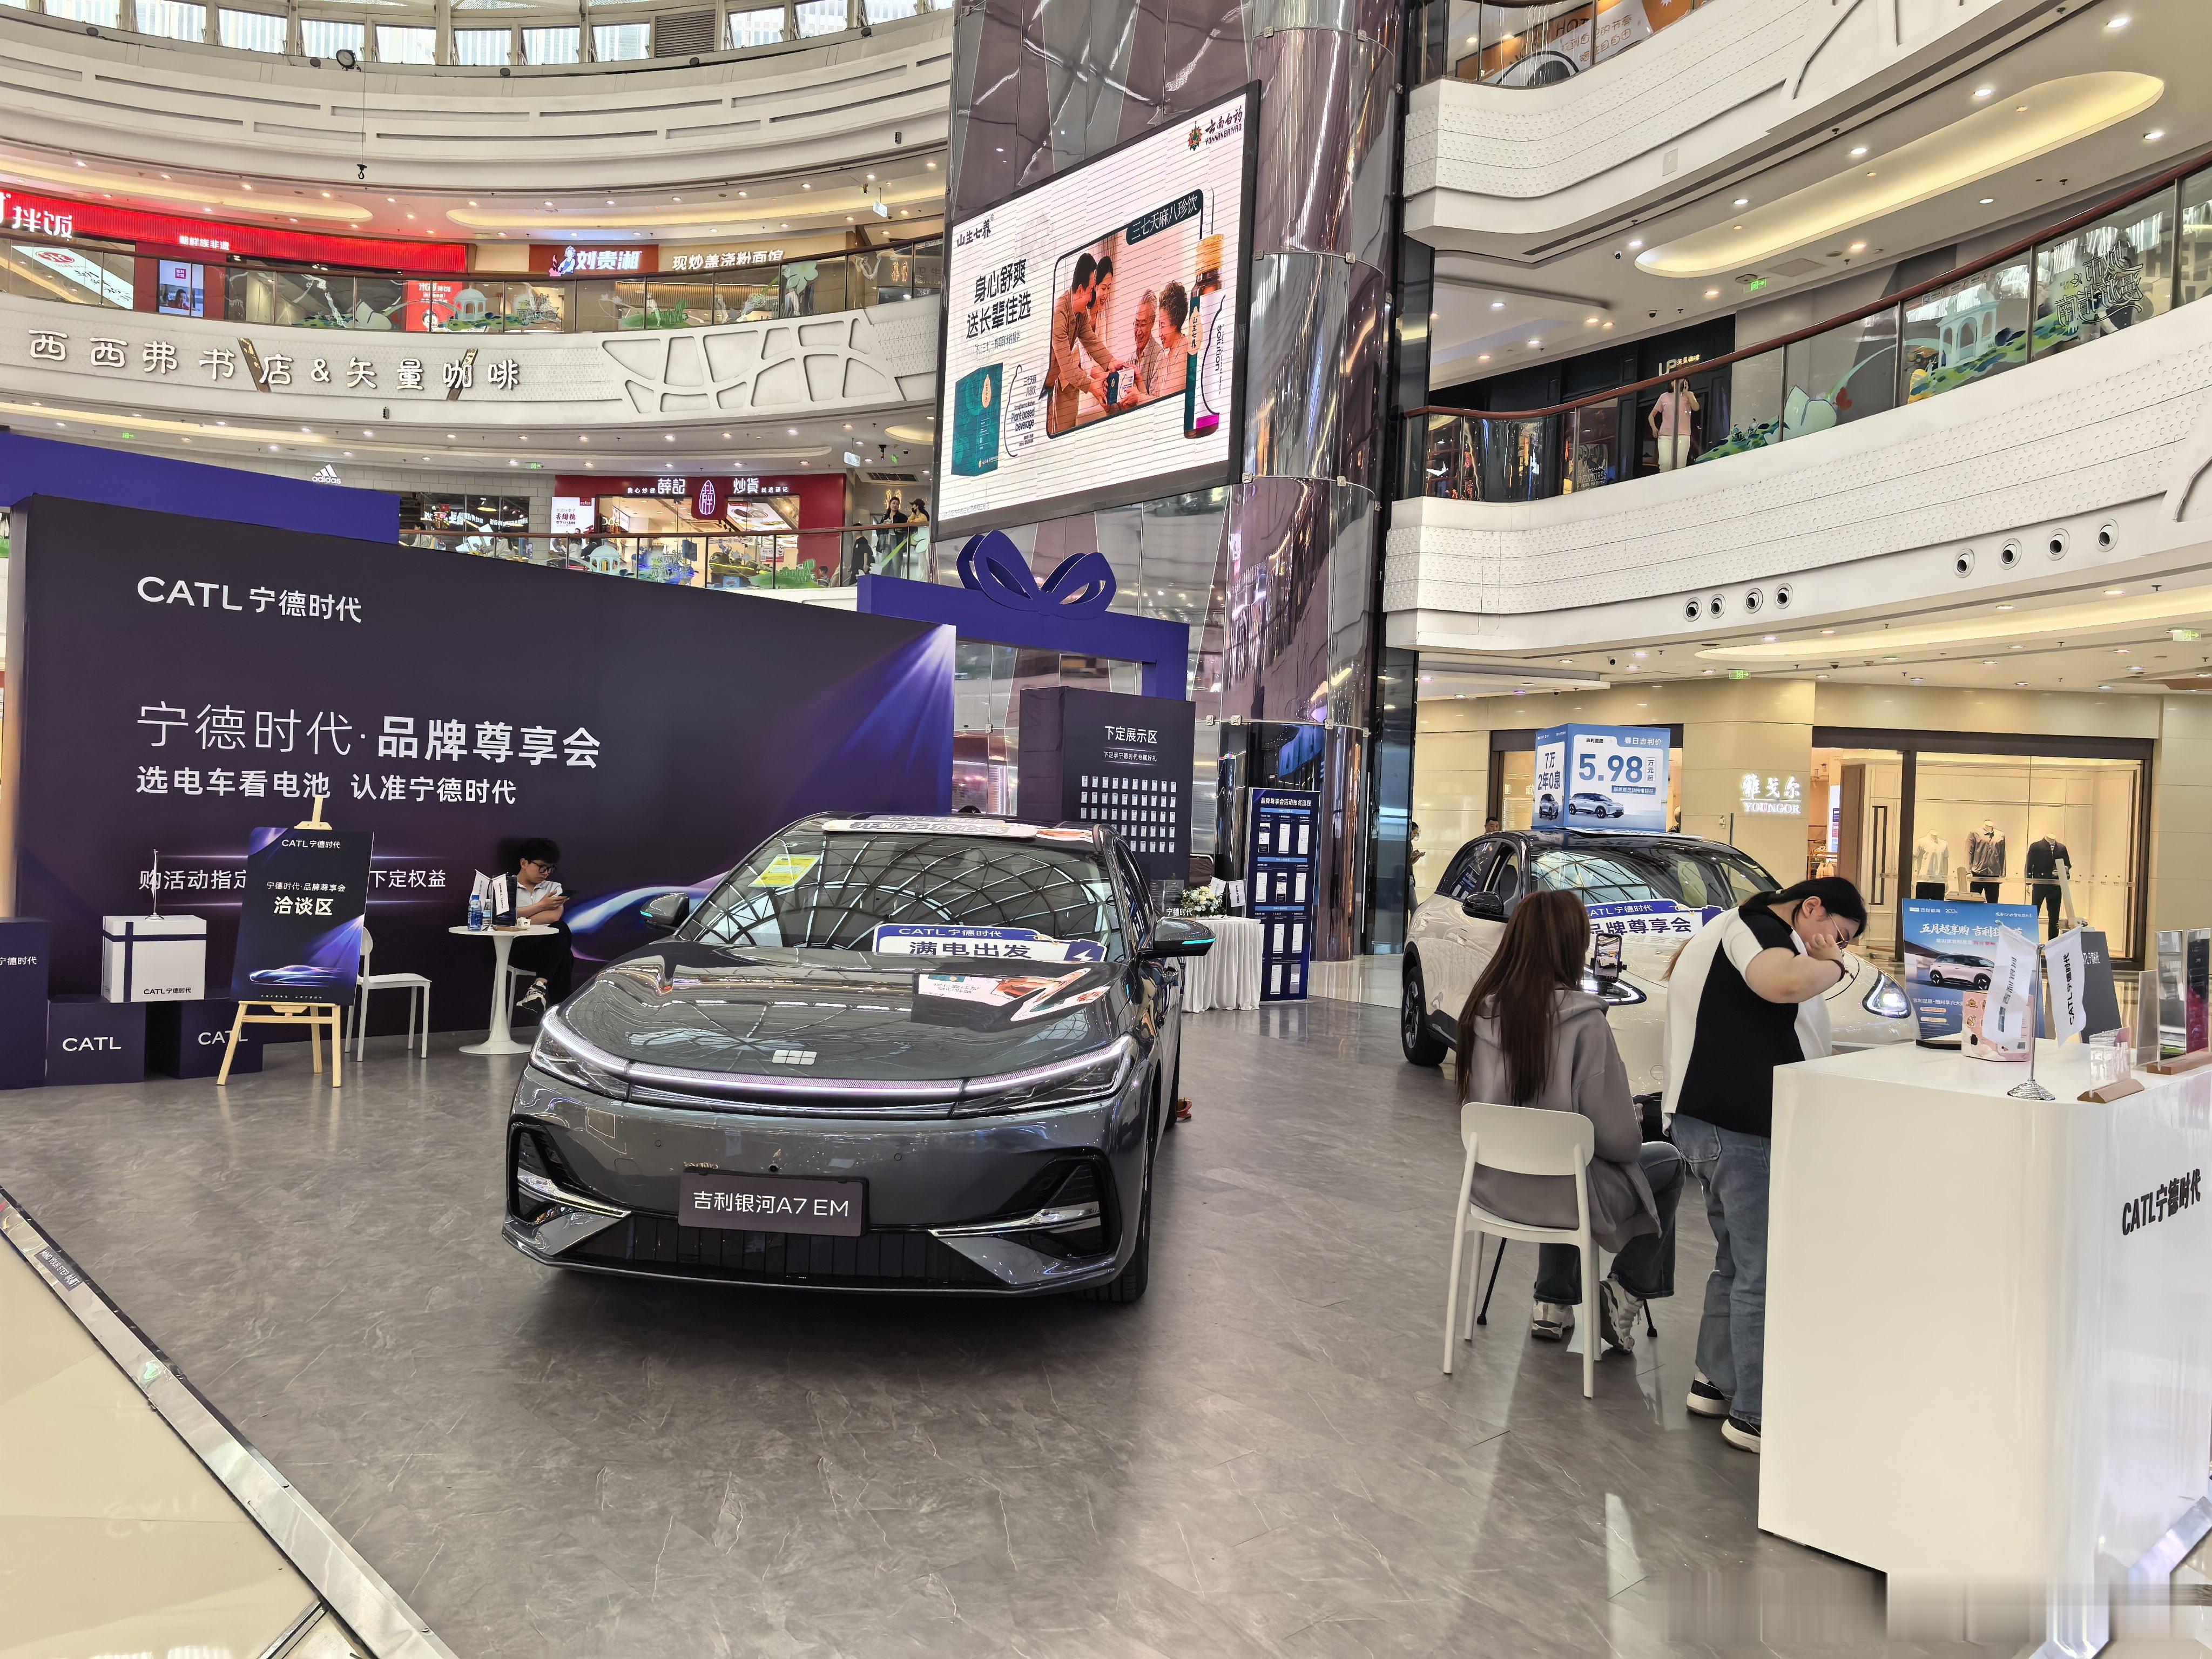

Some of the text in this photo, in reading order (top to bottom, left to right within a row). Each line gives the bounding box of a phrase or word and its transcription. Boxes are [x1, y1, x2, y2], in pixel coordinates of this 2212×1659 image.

[1205, 124, 1242, 145] YUNNANBAIYAO
[0, 192, 73, 241] 拌饭
[1131, 194, 1197, 240] 三七天麻八珍饮
[956, 218, 992, 247] 山生七养
[577, 250, 642, 270] 刘贵湘
[672, 249, 784, 271] 现炒盖浇粉面馆
[974, 259, 1027, 304] 身心舒爽
[966, 291, 1031, 339] 送长辈佳选
[29, 329, 520, 392] 西西弗书店&矢量咖啡
[1015, 419, 1035, 431] beverage
[733, 478, 759, 494] 炒貨
[137, 576, 361, 623] CATL 宁德时代
[137, 700, 601, 770] 宁德时代·品牌尊享会
[1104, 726, 1158, 744] 下定展示区
[1624, 737, 1662, 746] 春日吉利价
[1103, 751, 1157, 762] 下定享宁德时代专属好礼
[1545, 751, 1556, 770] 7万
[1579, 753, 1655, 783] 5.98 万元起
[136, 765, 517, 806] 选电车看电池 认准宁德时代
[1537, 770, 1561, 791] 2年0息
[1741, 773, 1800, 798] 雅戈尔
[1743, 802, 1802, 814] YOUNGOR
[281, 839, 340, 849] CATL 宁德时代
[370, 869, 446, 888] 下定权益
[273, 896, 334, 916] 洽谈区
[1614, 904, 1654, 913] 宁德时代
[948, 929, 1002, 938] 宁德时代
[909, 941, 1032, 959] 满电出发
[0, 956, 37, 966] 宁德时代
[2067, 993, 2075, 1025] CATL
[62, 1037, 122, 1051] CATL
[693, 1190, 849, 1217] 吉利银河A7 EM
[2122, 1168, 2201, 1236] CATL 宁德时代
